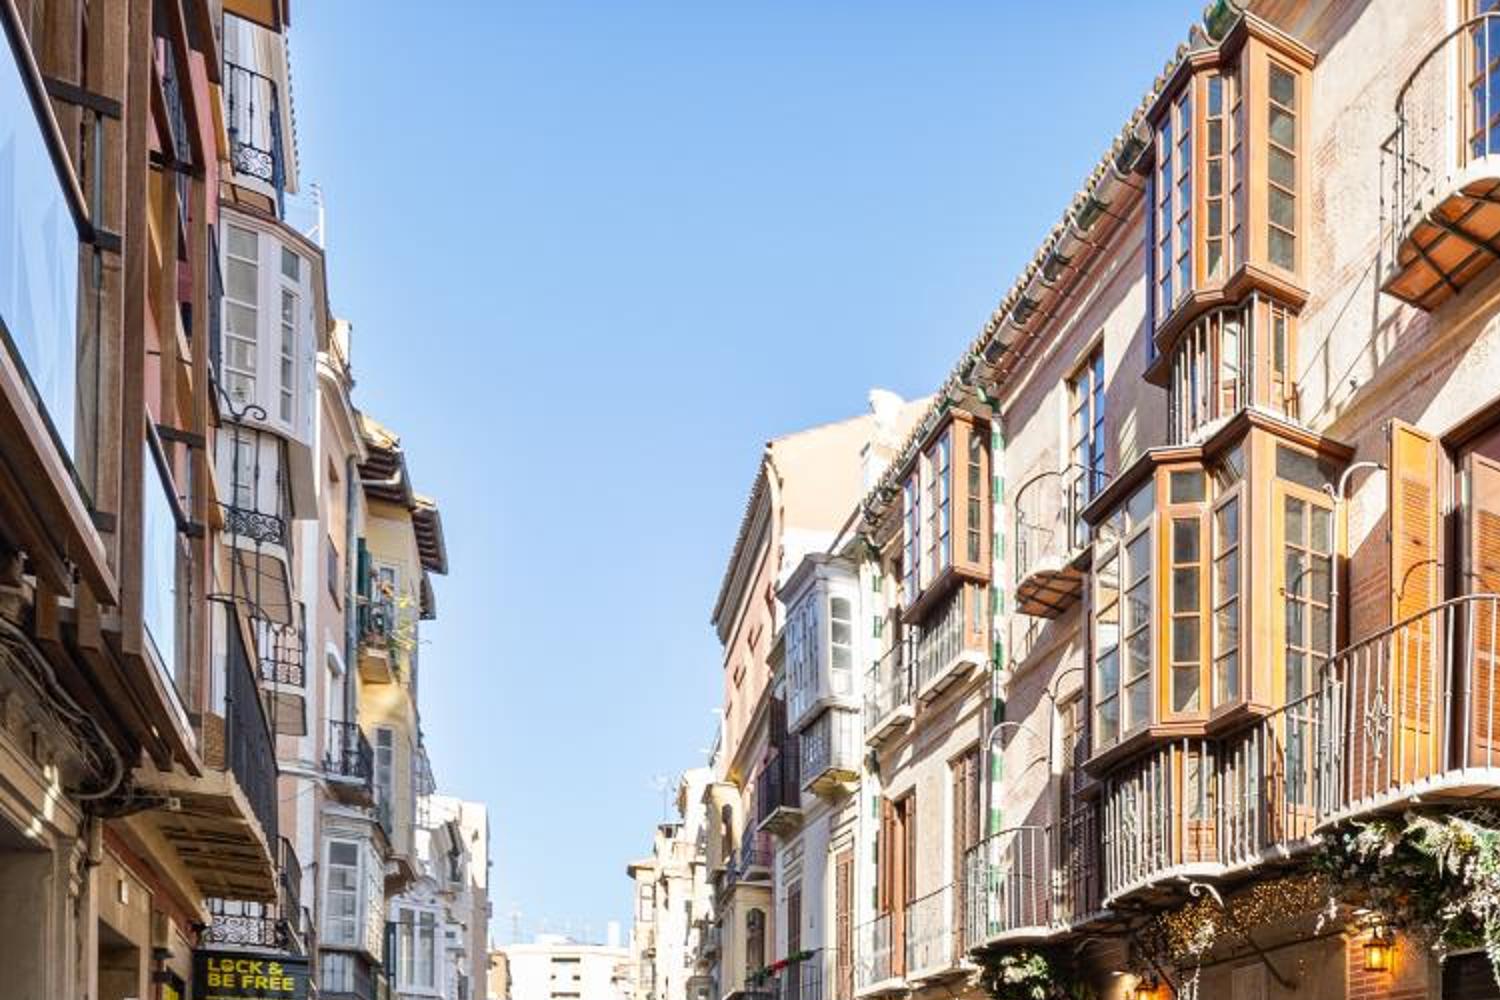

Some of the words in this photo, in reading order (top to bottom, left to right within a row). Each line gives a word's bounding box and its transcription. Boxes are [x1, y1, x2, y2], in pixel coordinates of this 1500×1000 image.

[207, 958, 263, 975] LOCK
[268, 961, 283, 976] &
[207, 974, 235, 987] BE
[241, 976, 295, 991] FREE
